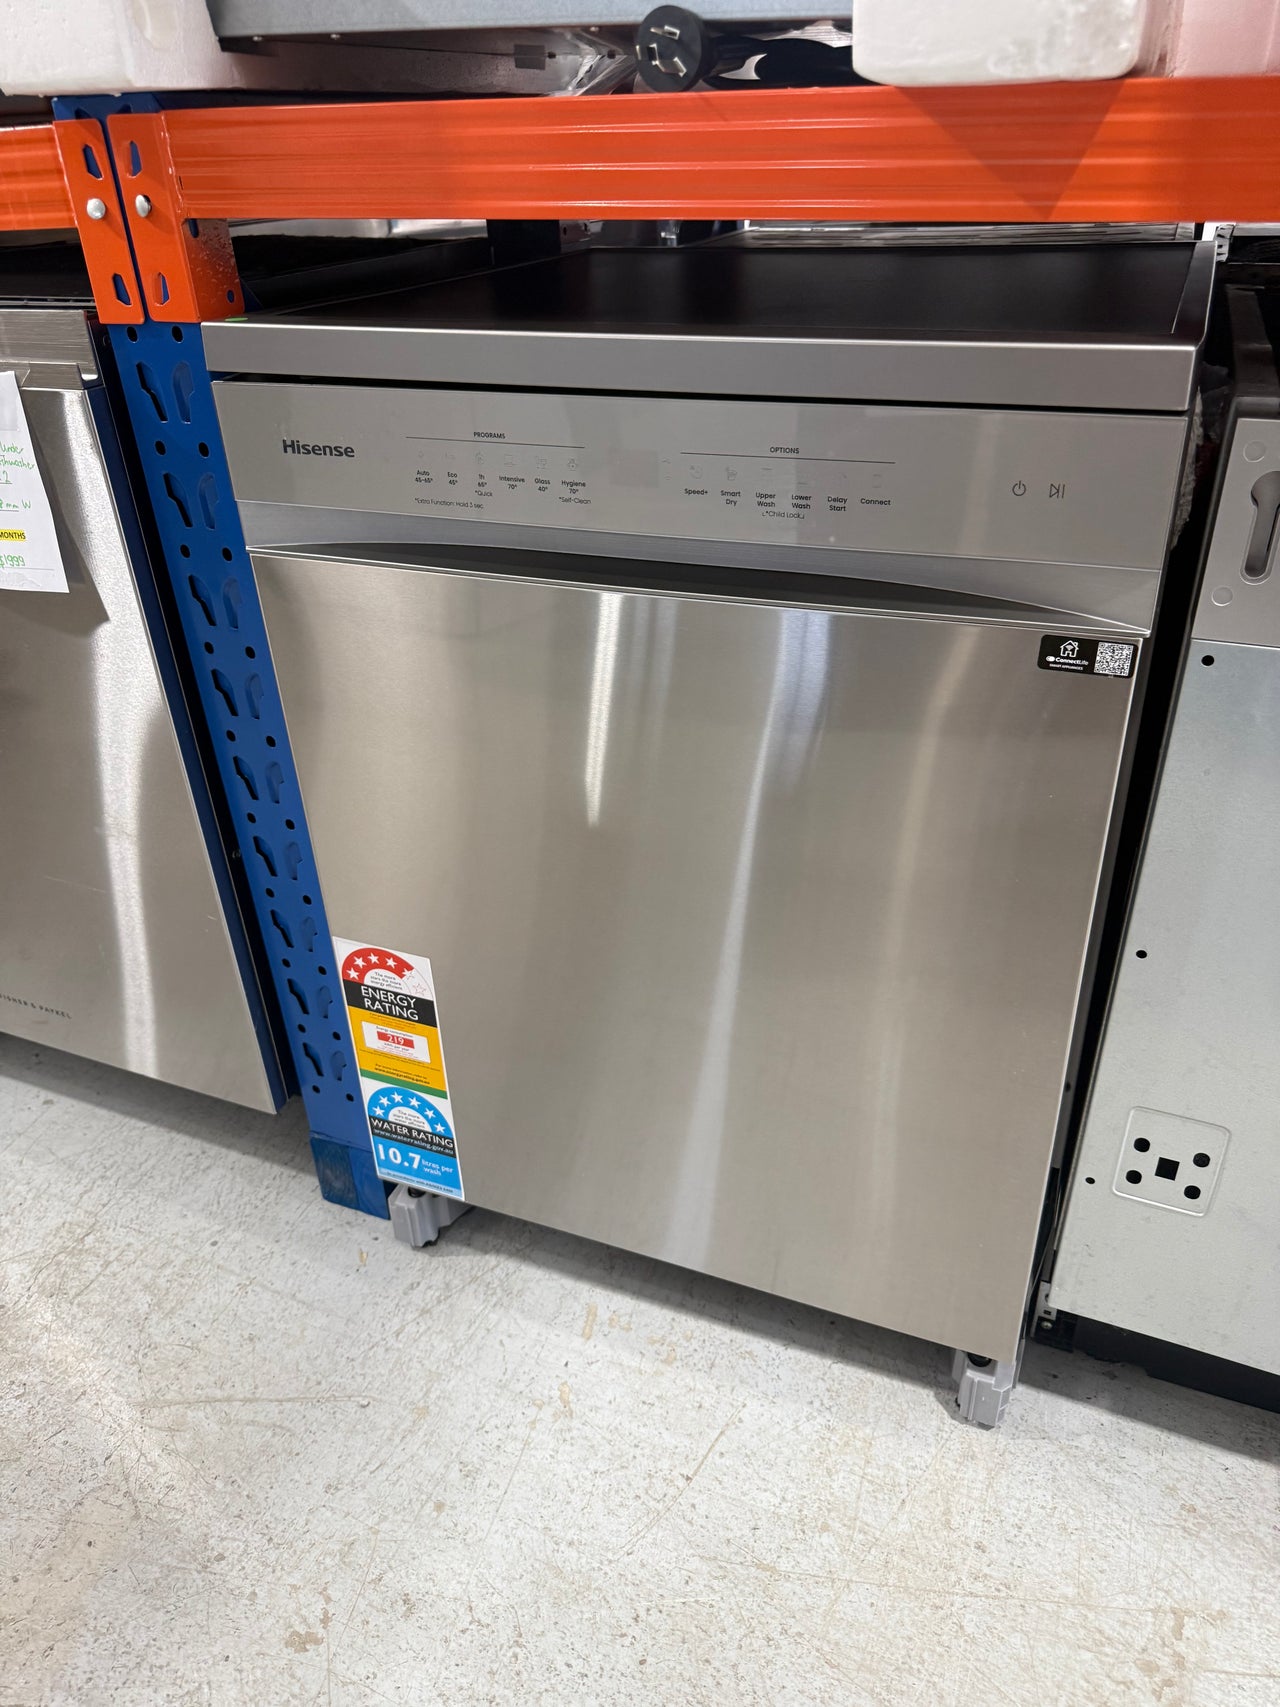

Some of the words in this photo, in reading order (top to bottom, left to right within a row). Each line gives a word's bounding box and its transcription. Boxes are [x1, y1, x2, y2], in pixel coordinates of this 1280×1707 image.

[474, 431, 506, 439] PROGRAMS
[282, 439, 355, 458] Hisense
[769, 446, 800, 454] OPTIONS
[499, 475, 525, 483] Intensive
[561, 479, 586, 488] Hygiene
[684, 488, 708, 496] Speed+
[755, 492, 776, 500] Upper
[726, 499, 738, 507] Dry
[757, 500, 776, 508] Wash
[827, 496, 848, 504] Delay
[860, 498, 891, 506] Connect
[829, 504, 847, 512] Start
[361, 985, 416, 1008] ENERGY
[364, 998, 418, 1020] RATING
[387, 1034, 404, 1045] 219
[371, 1118, 410, 1136] WATER
[412, 1129, 454, 1148] RATING
[378, 1143, 421, 1169] 10.7
[421, 1159, 440, 1169] litres
[423, 1167, 441, 1176] wash
